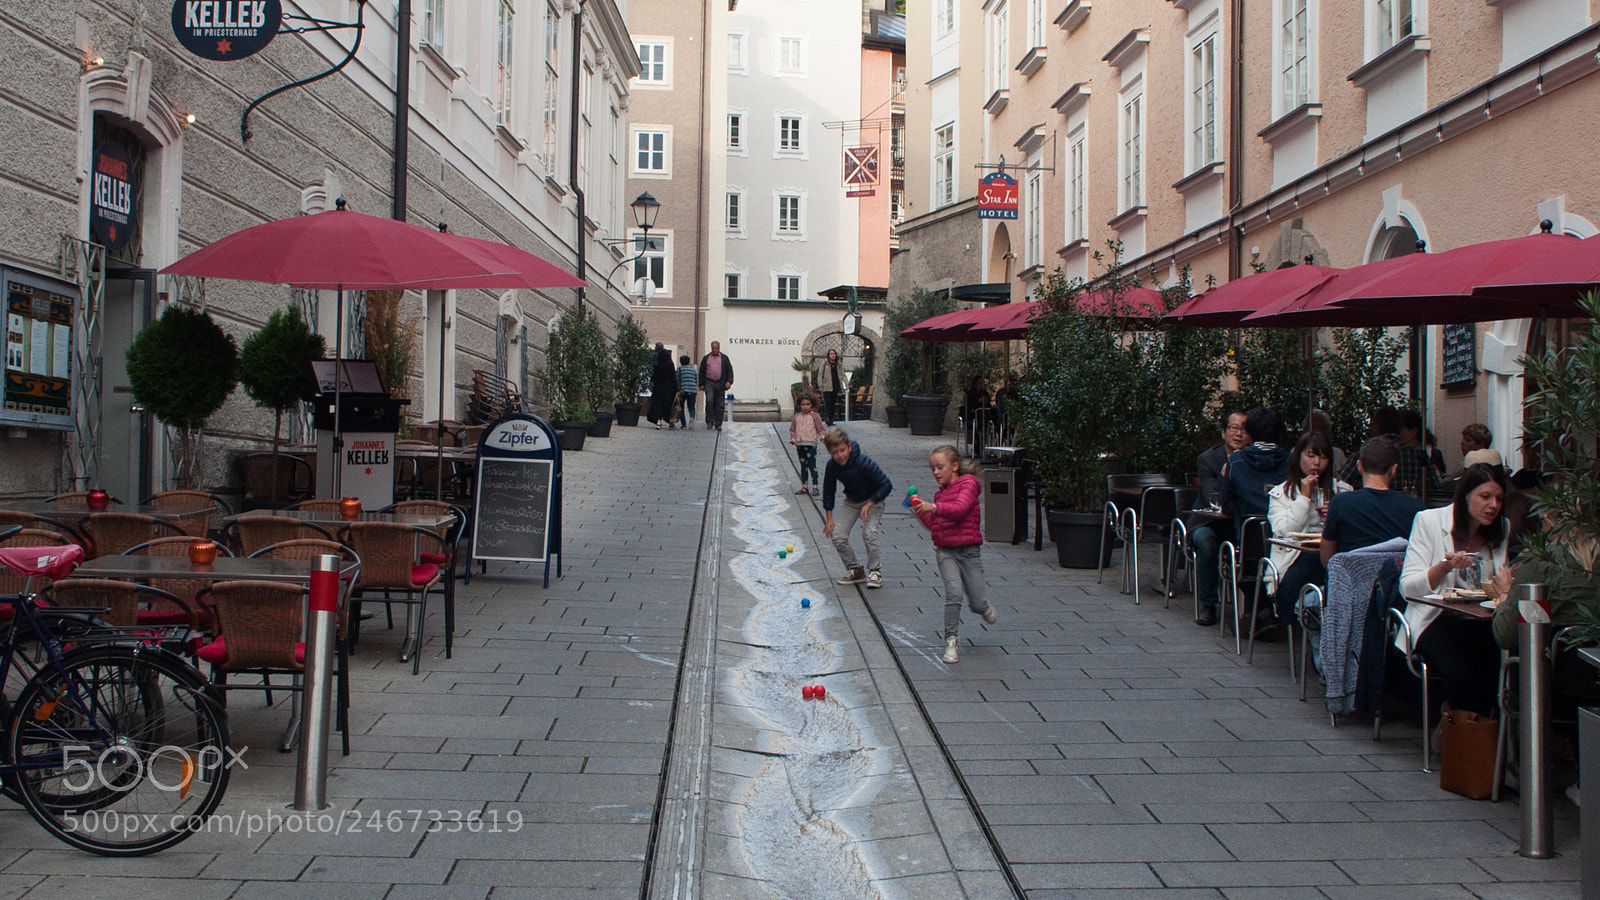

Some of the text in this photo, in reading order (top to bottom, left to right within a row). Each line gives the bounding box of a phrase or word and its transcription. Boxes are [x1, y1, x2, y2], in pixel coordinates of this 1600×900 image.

[185, 0, 266, 28] KELLER
[204, 28, 258, 37] PRIESTERHAUS
[95, 172, 132, 215] KELLER
[980, 210, 1016, 218] HOTEL
[729, 337, 774, 345] SCHWARZES
[351, 440, 385, 449] JOHANNES
[499, 431, 539, 447] Zipfer
[347, 450, 389, 465] KELLER
